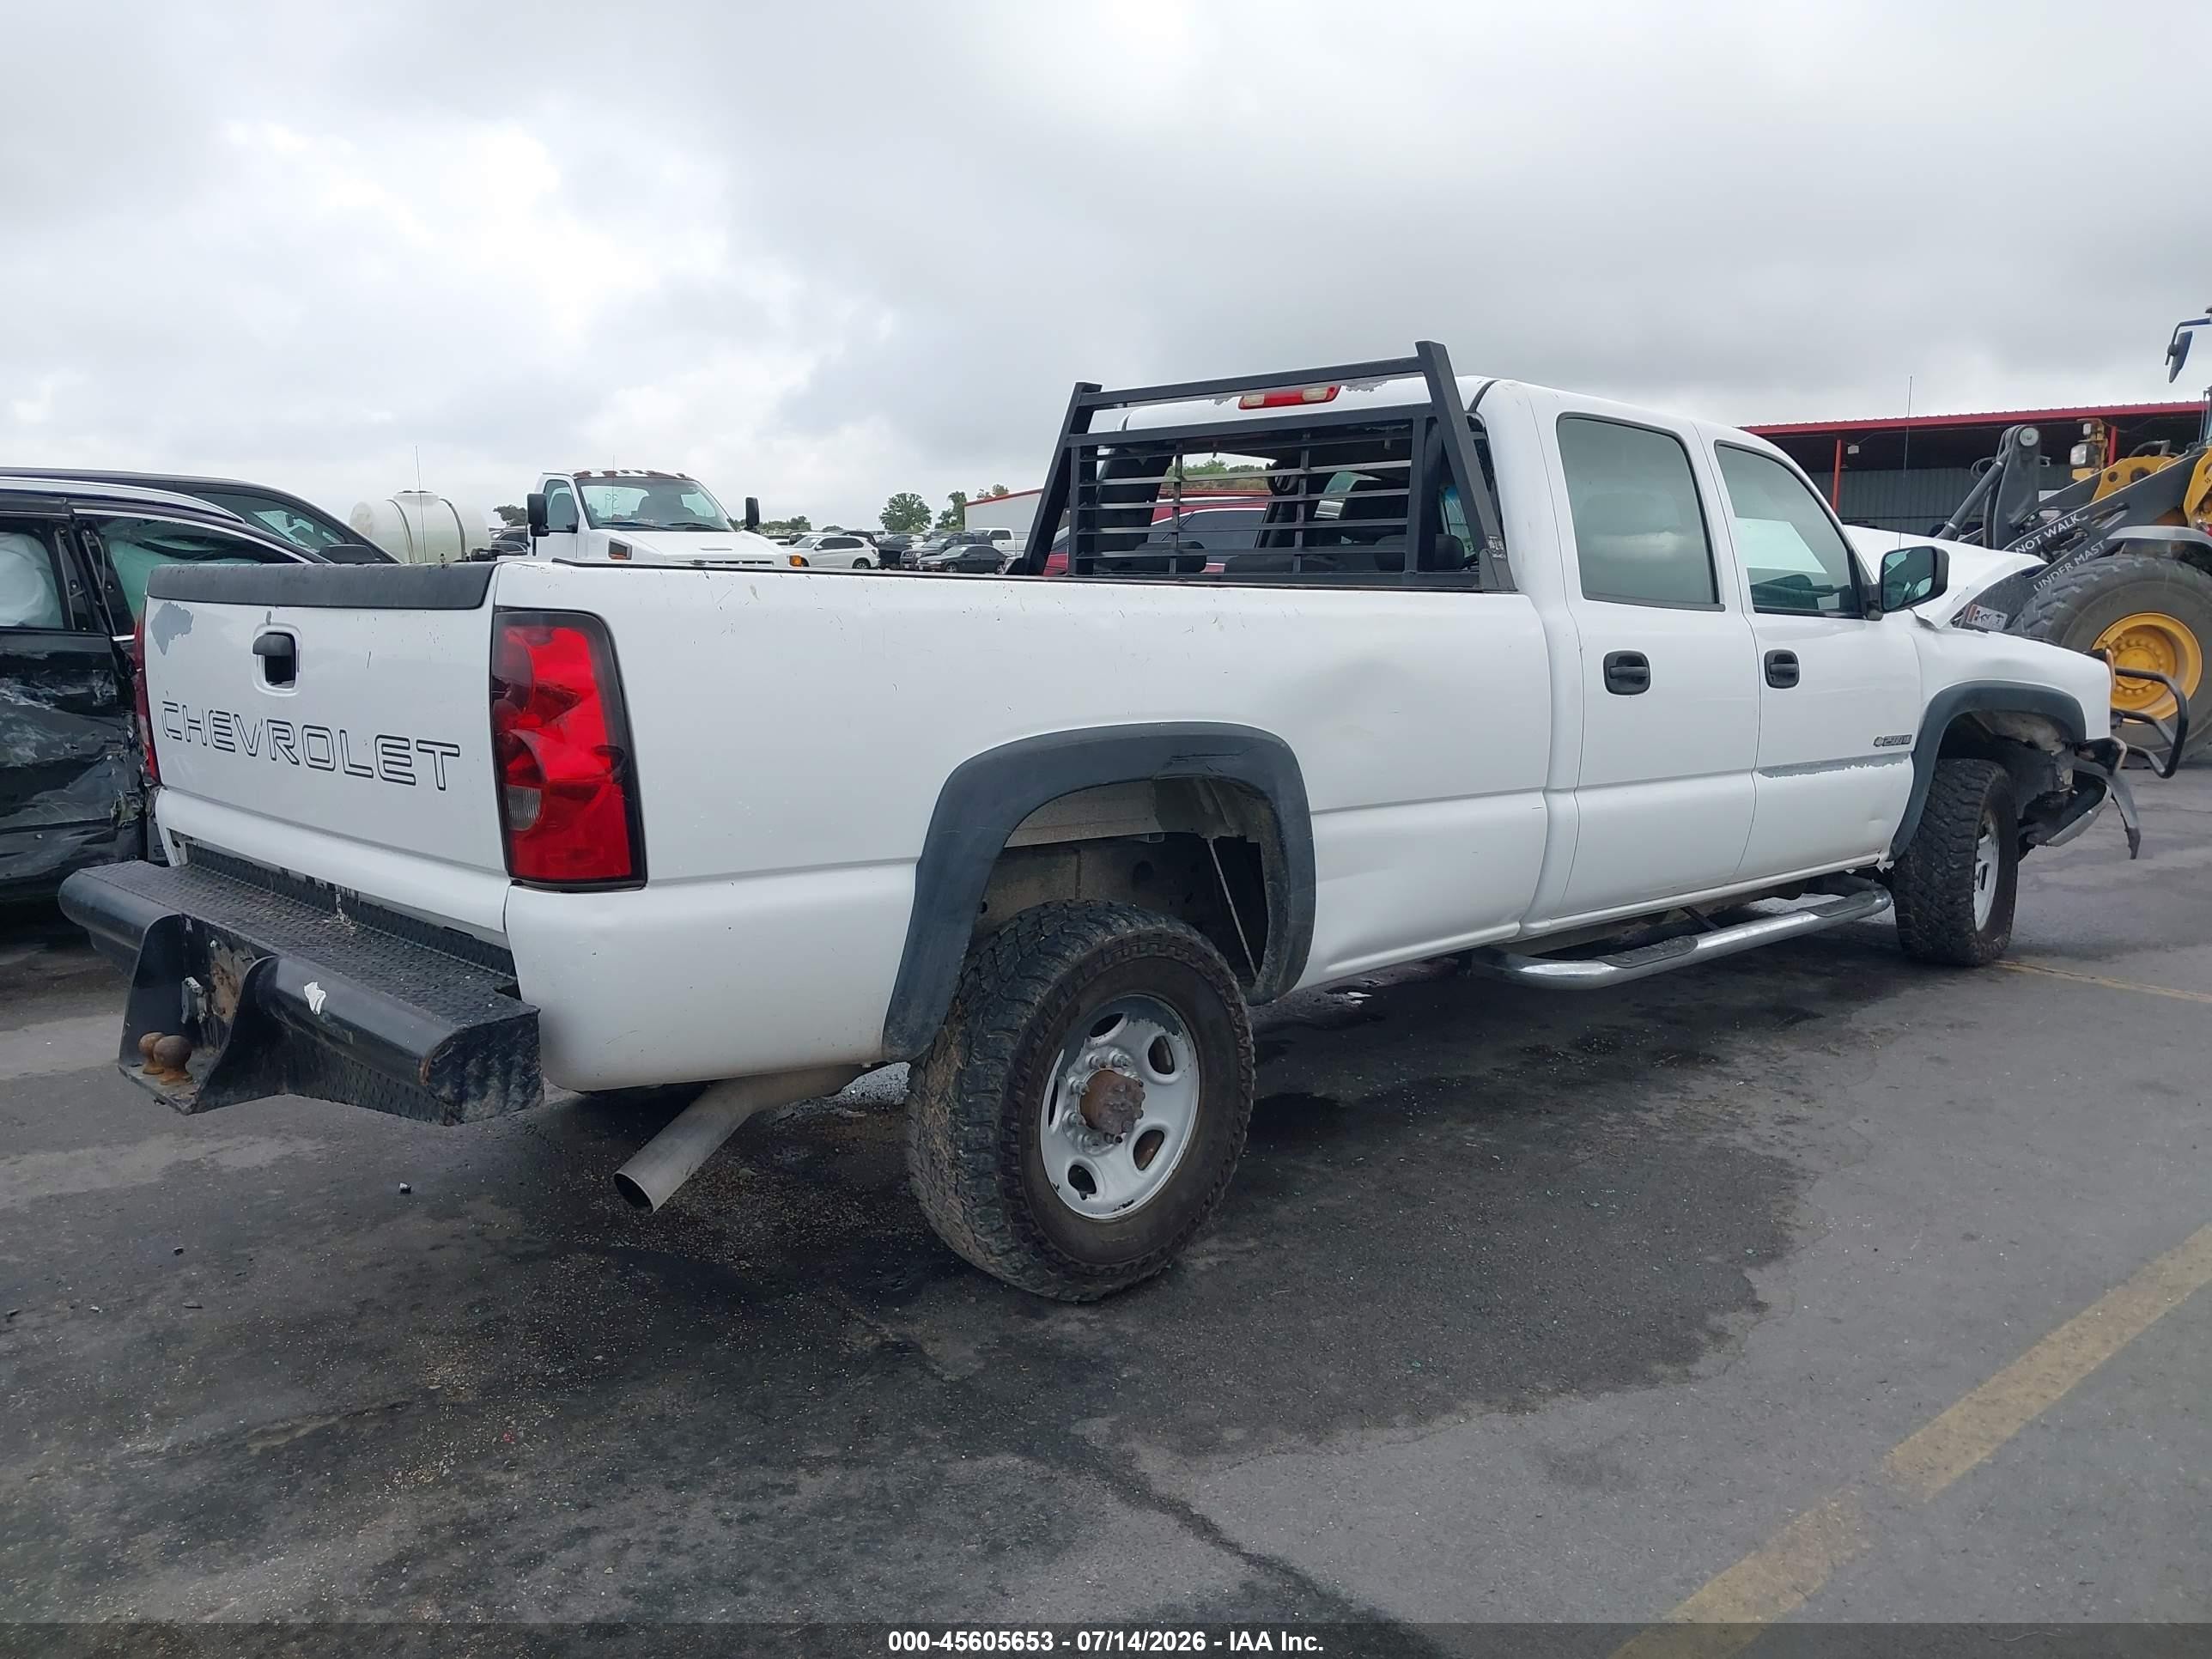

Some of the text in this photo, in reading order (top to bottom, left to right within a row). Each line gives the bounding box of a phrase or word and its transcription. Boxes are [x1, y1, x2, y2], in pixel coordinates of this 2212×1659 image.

[2014, 514, 2081, 554] NOT WALK
[2033, 540, 2106, 592] UNDER MAST
[161, 700, 460, 792] CHEVROLET
